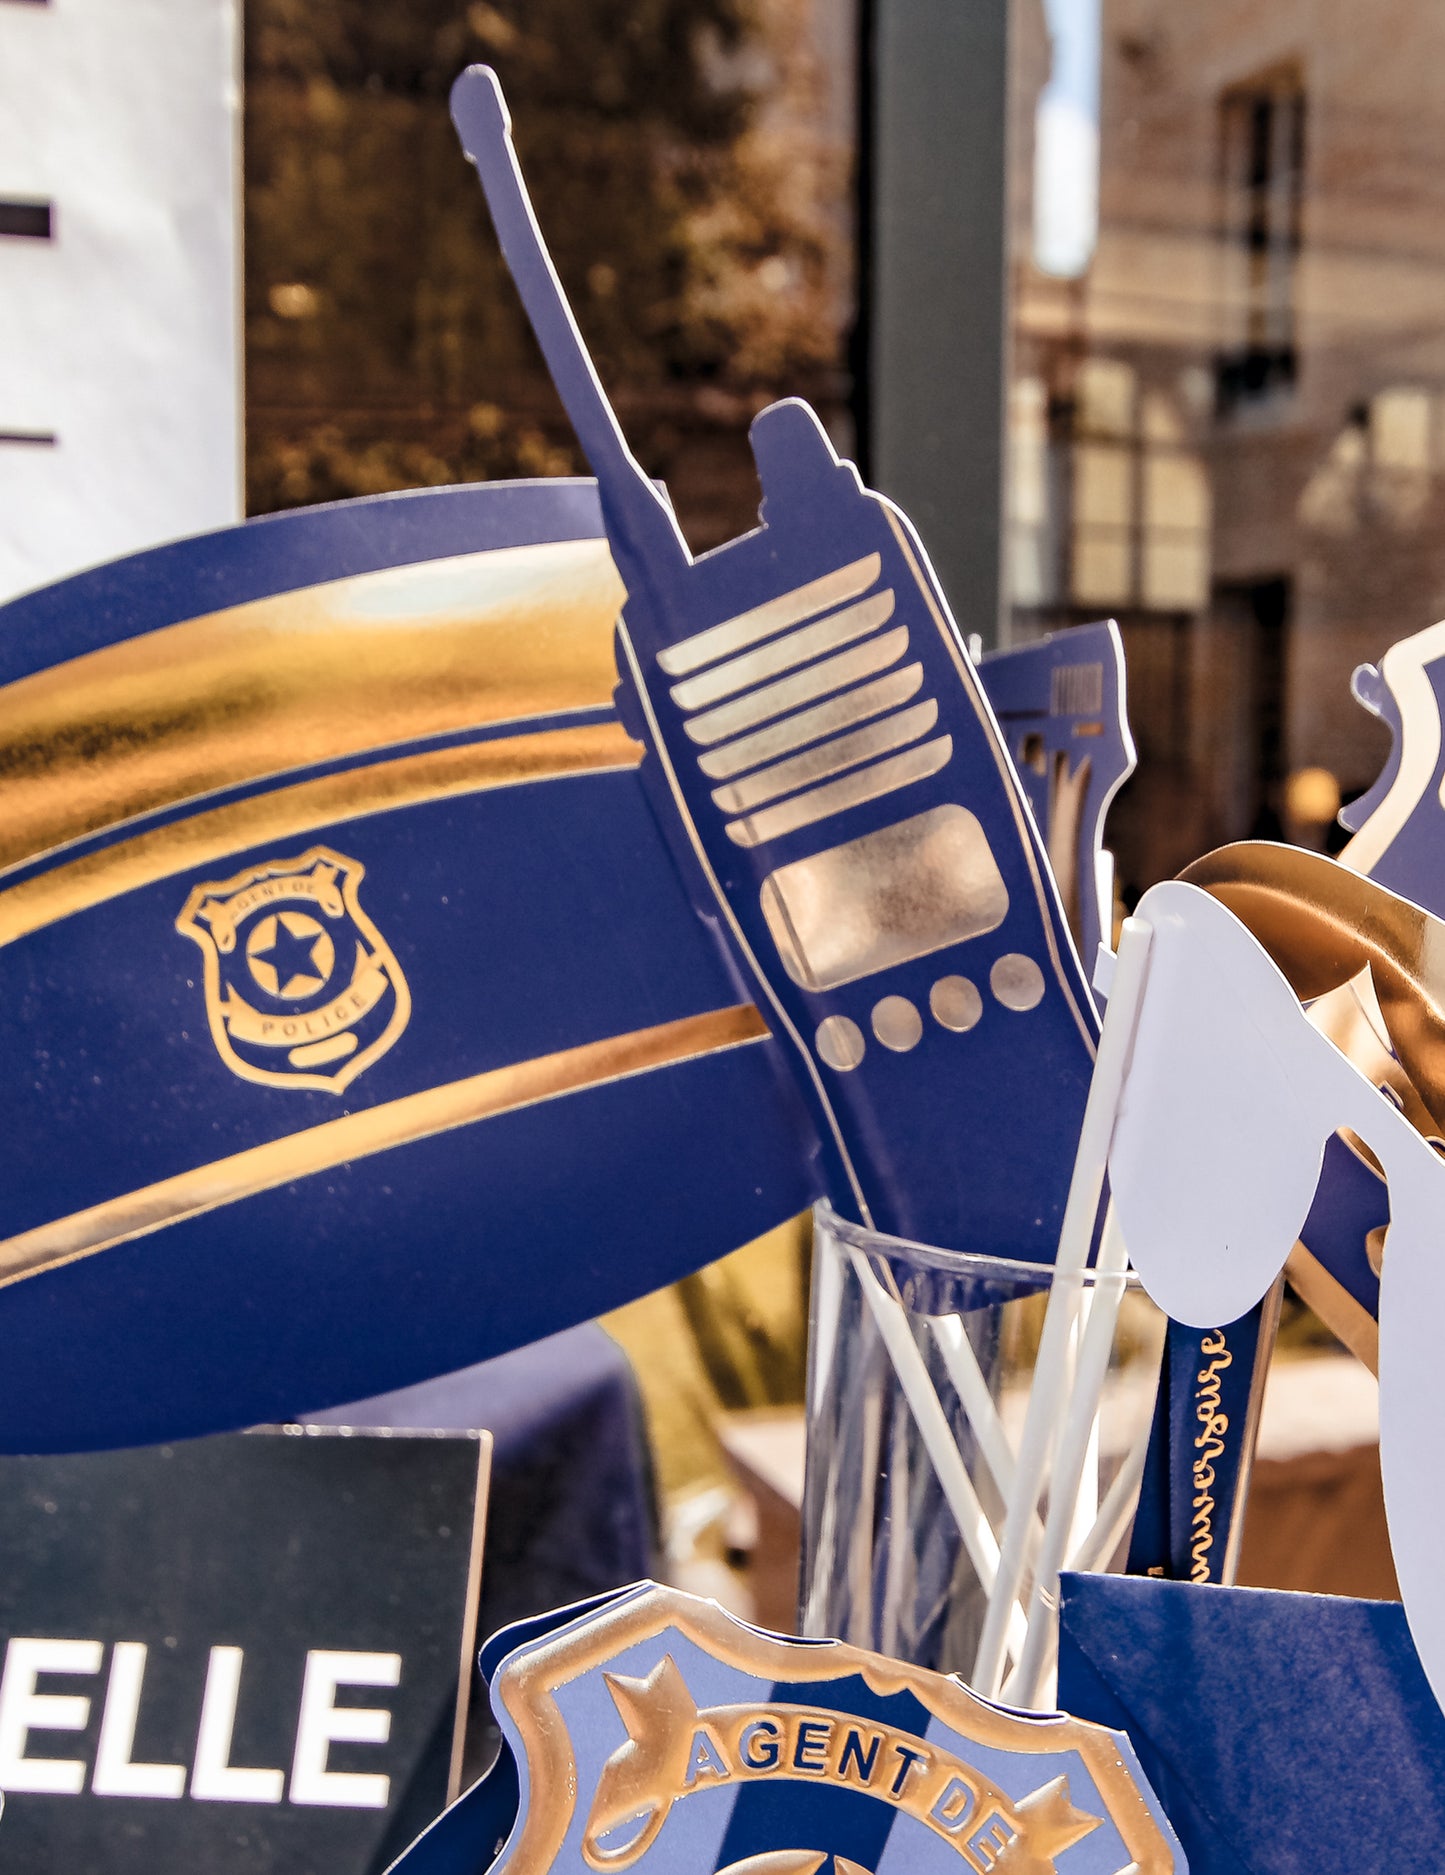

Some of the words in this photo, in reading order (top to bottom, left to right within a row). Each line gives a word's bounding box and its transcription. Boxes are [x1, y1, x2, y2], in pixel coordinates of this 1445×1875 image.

[261, 992, 367, 1036] POLICE
[0, 1637, 402, 1809] ELLE
[682, 1717, 932, 1800] AGENT
[928, 1773, 1020, 1873] DE
